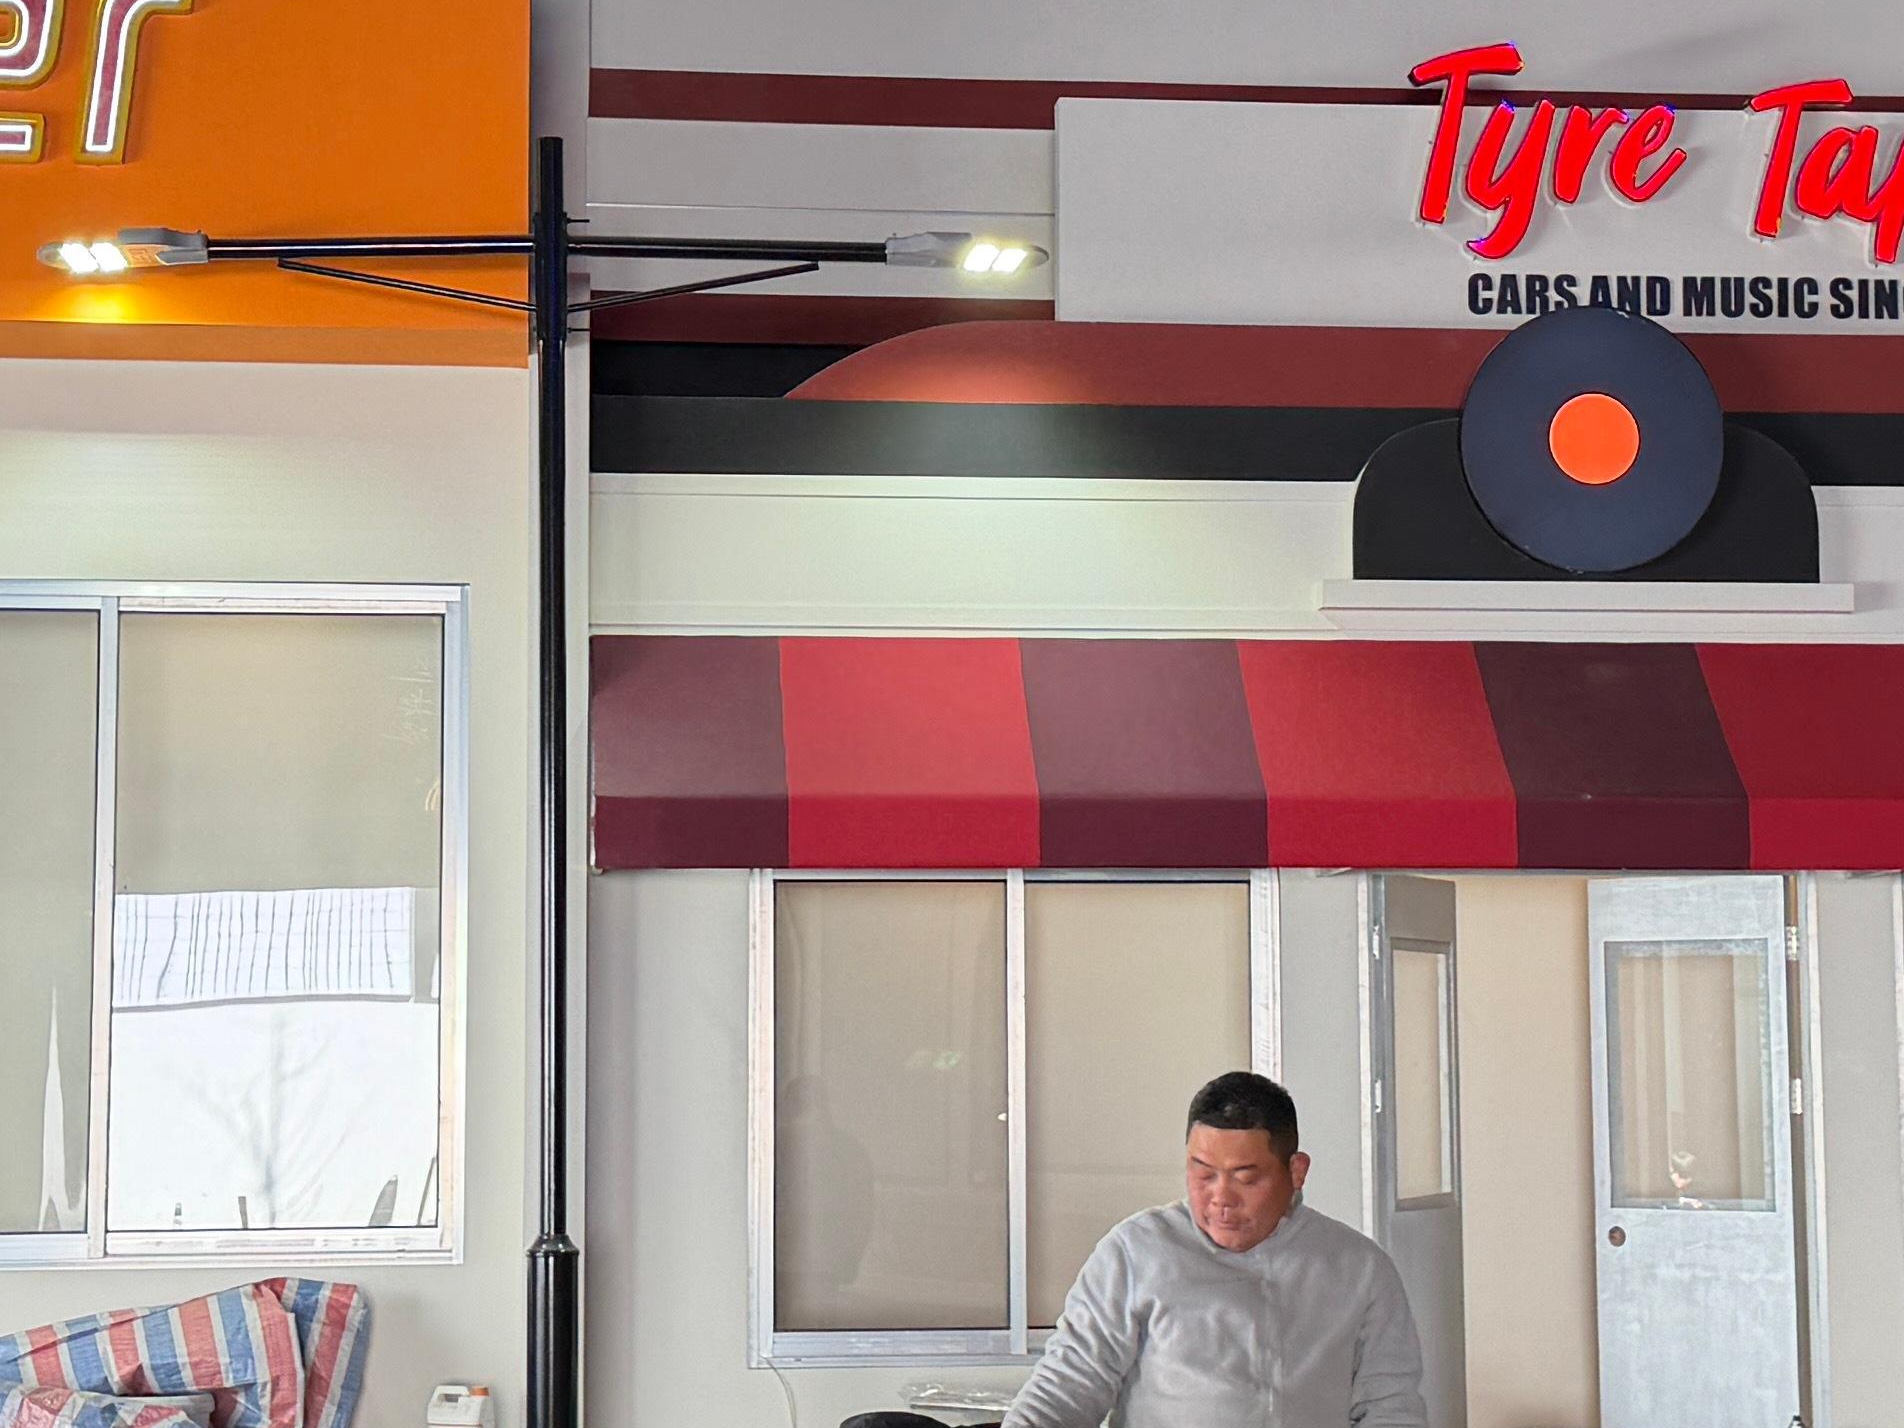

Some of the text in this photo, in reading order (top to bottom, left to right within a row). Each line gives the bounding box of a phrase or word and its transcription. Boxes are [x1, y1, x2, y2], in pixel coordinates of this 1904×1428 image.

[1408, 41, 1687, 260] Tyre
[1467, 273, 1578, 316] CARS
[1589, 275, 1671, 317] AND
[1682, 275, 1820, 319] MUSIC
